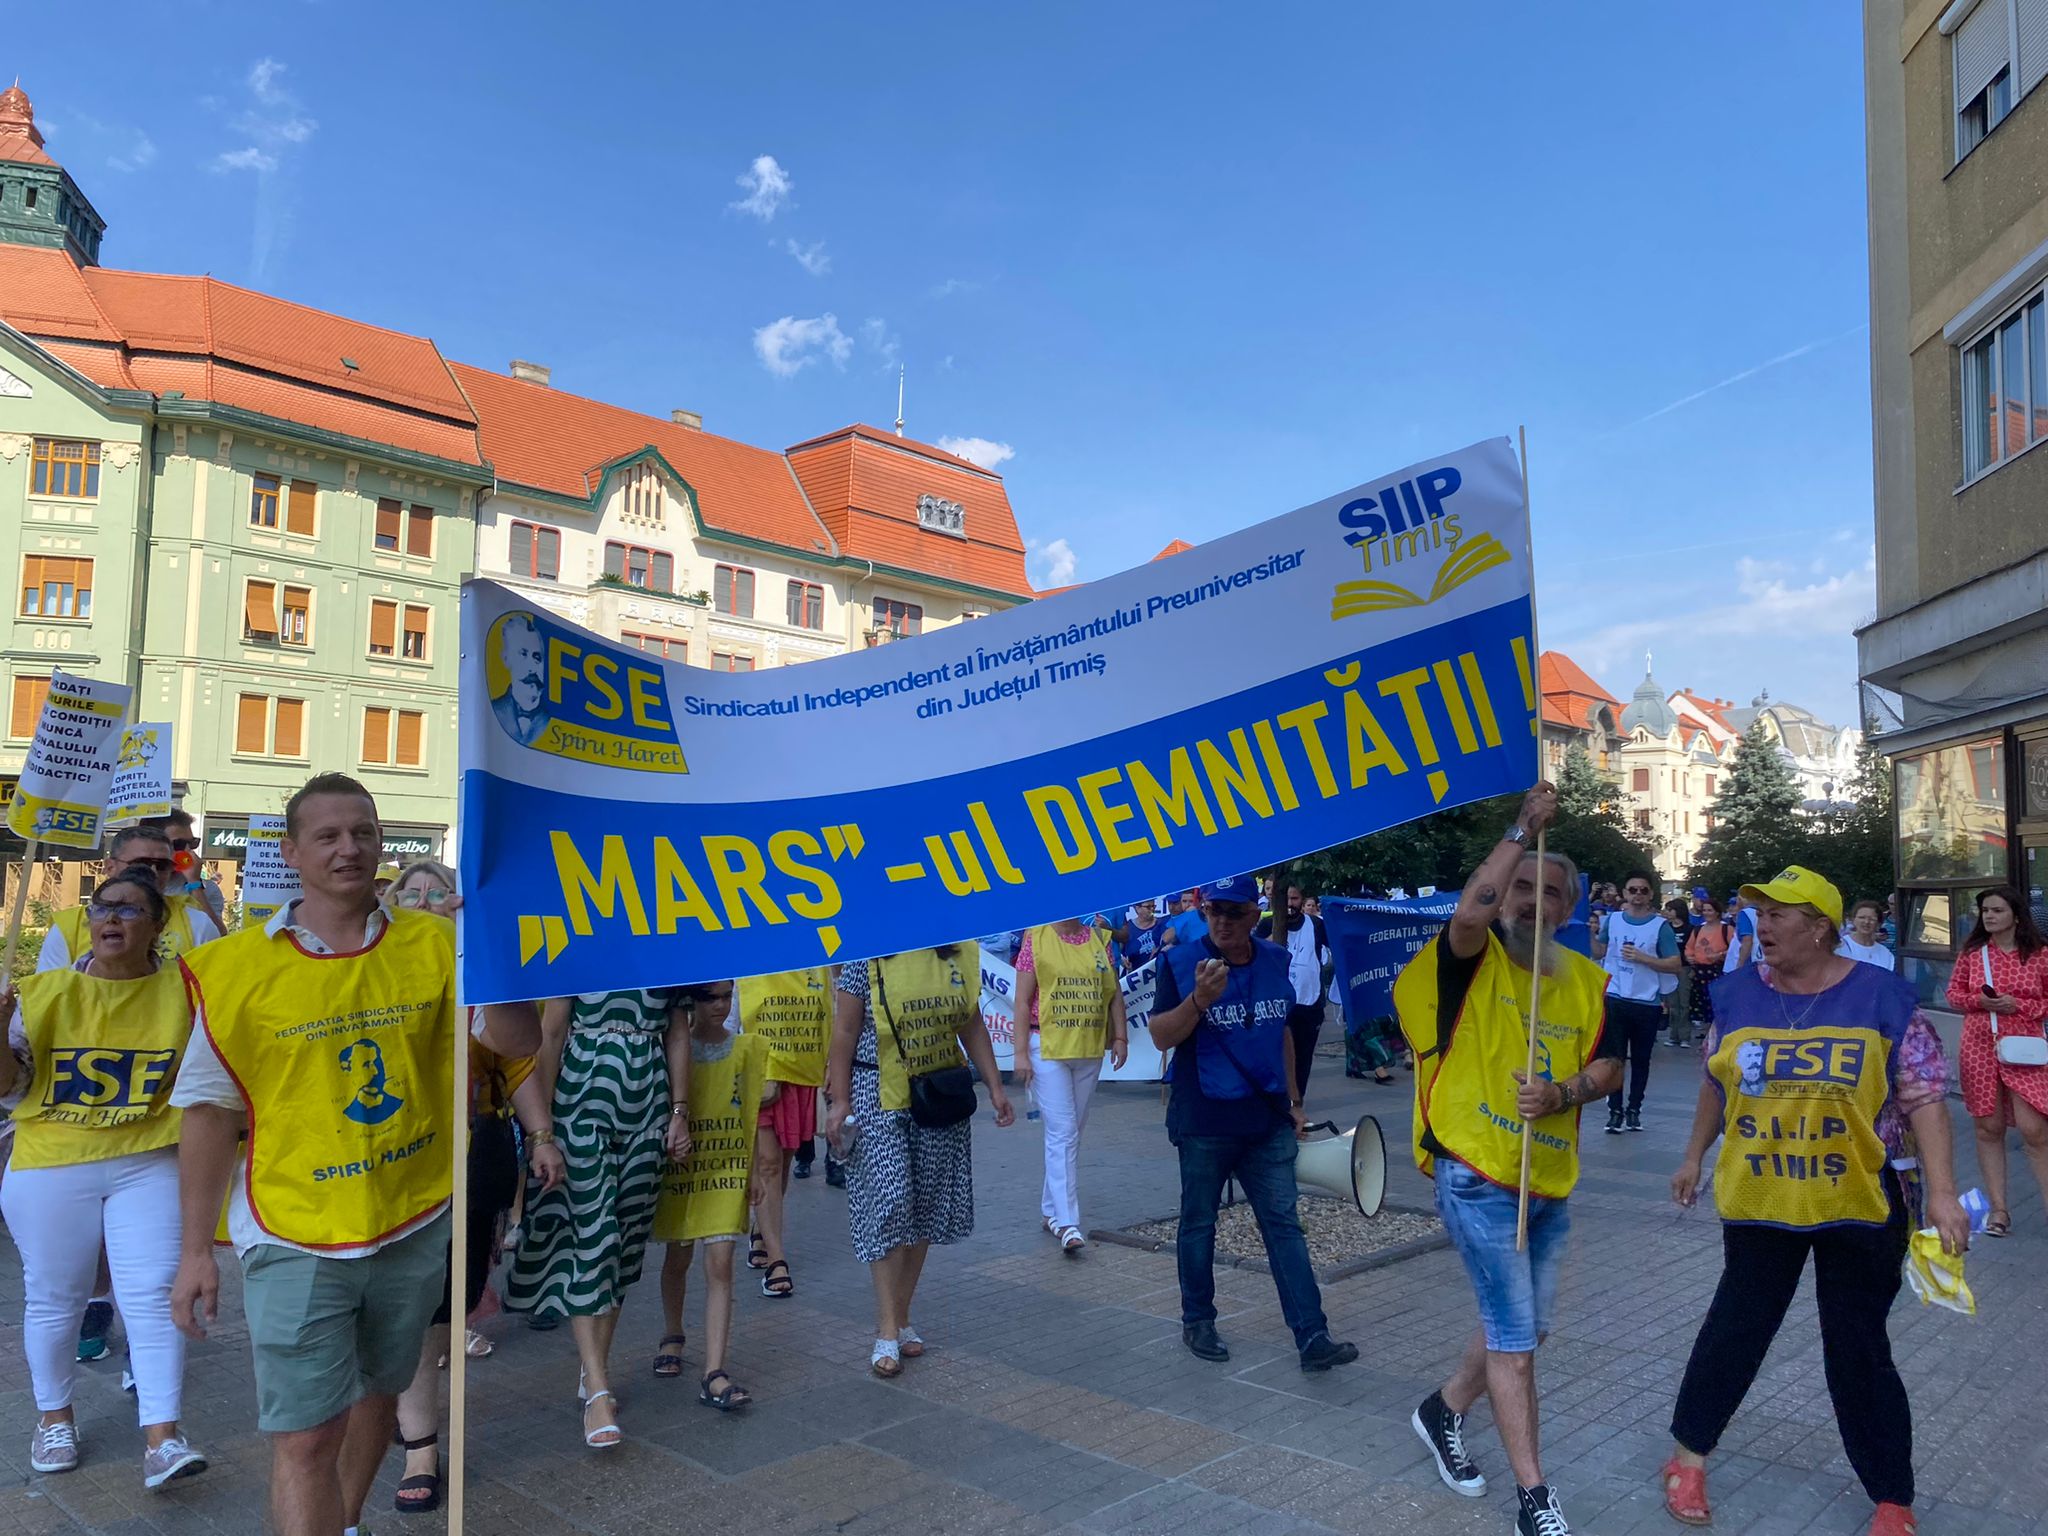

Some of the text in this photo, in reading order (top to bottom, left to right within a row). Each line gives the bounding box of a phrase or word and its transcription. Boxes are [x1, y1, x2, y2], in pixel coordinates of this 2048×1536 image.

[1338, 467, 1462, 546] SIIP
[1352, 513, 1463, 573] Timiș
[683, 547, 1305, 718] Sindicatul Independent al Învățământului Preuniversitar
[549, 637, 671, 730] FSE
[916, 650, 1107, 720] din Județul Timiș
[44, 753, 111, 772] AUXILIAR
[550, 724, 680, 766] Spiru Haret
[1022, 651, 1504, 875] DEMNITĂȚII
[51, 810, 97, 832] FSE
[249, 840, 279, 849] PENTRU
[259, 851, 270, 859] DE
[245, 870, 281, 879] DIDACTIC
[1369, 926, 1418, 945] FEDERAȚIA
[346, 1001, 433, 1021] SINDICATELOR
[305, 1030, 328, 1042] DIN
[44, 1049, 173, 1106] FSE
[1764, 1041, 1861, 1081] FSE
[312, 1131, 437, 1182] SPIRU HARET
